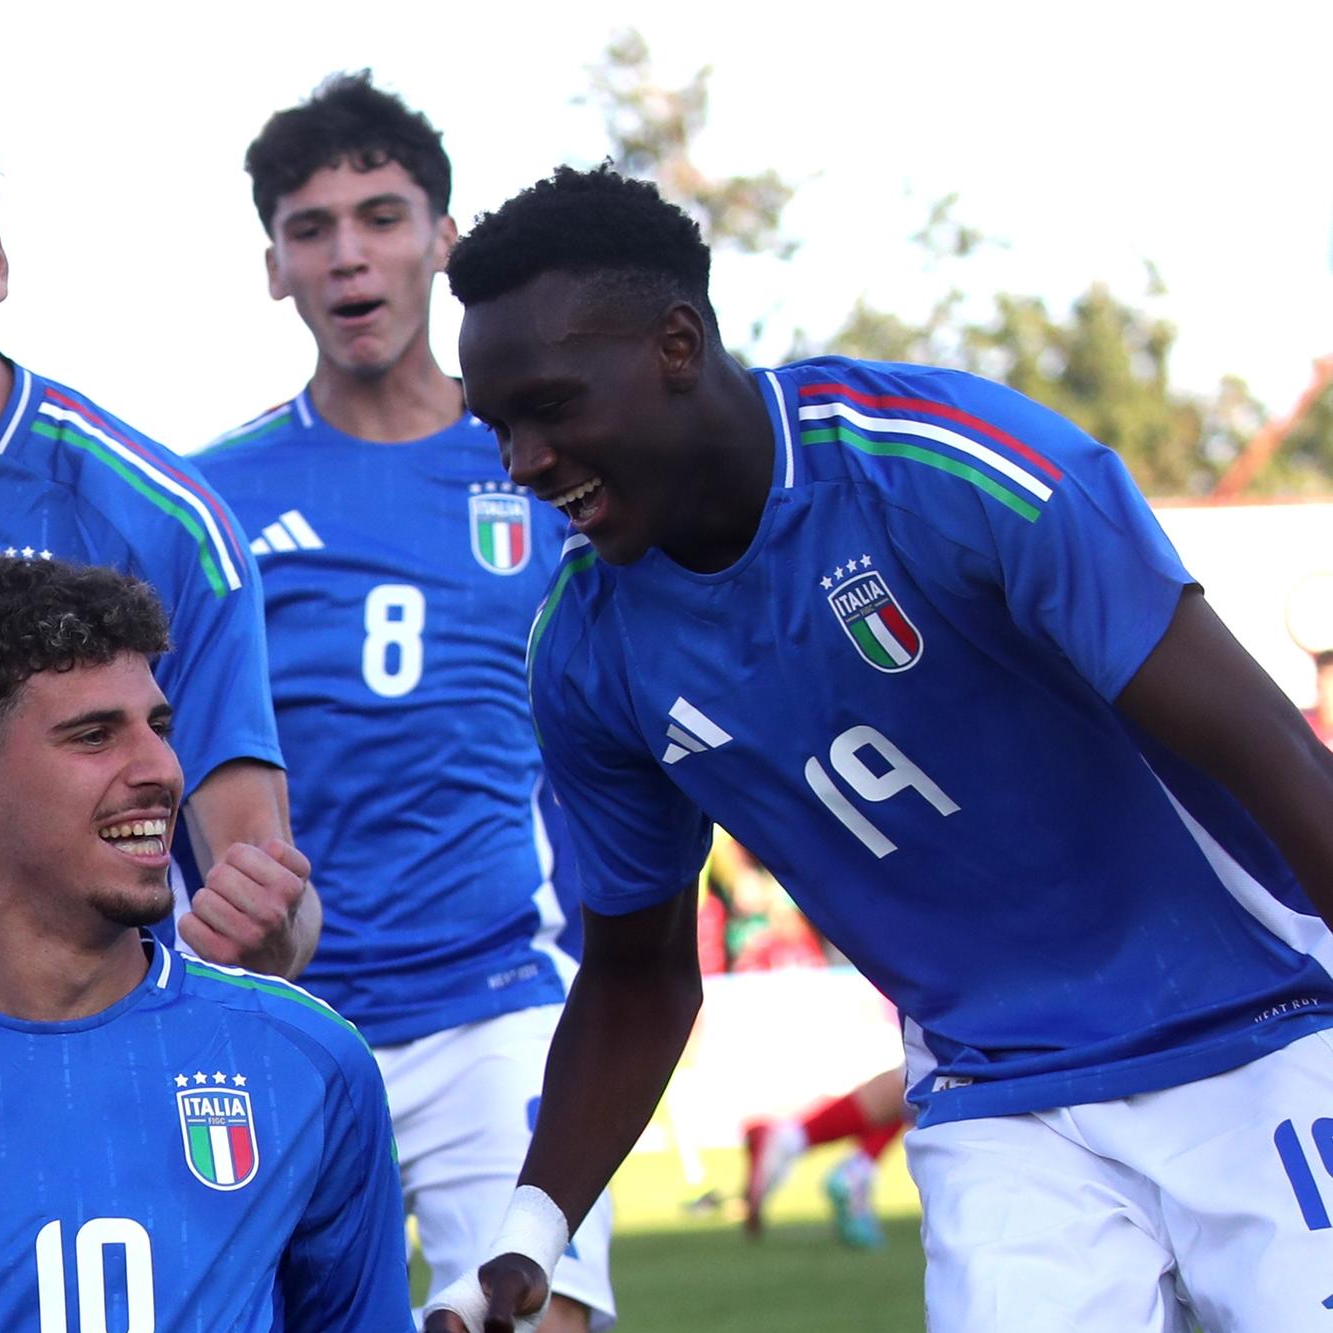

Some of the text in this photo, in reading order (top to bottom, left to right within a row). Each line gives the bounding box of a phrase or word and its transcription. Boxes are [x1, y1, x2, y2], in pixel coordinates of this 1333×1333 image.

[834, 580, 885, 617] ITALIA
[362, 584, 425, 698] 8
[804, 725, 961, 859] 19
[184, 1098, 246, 1116] ITALIA
